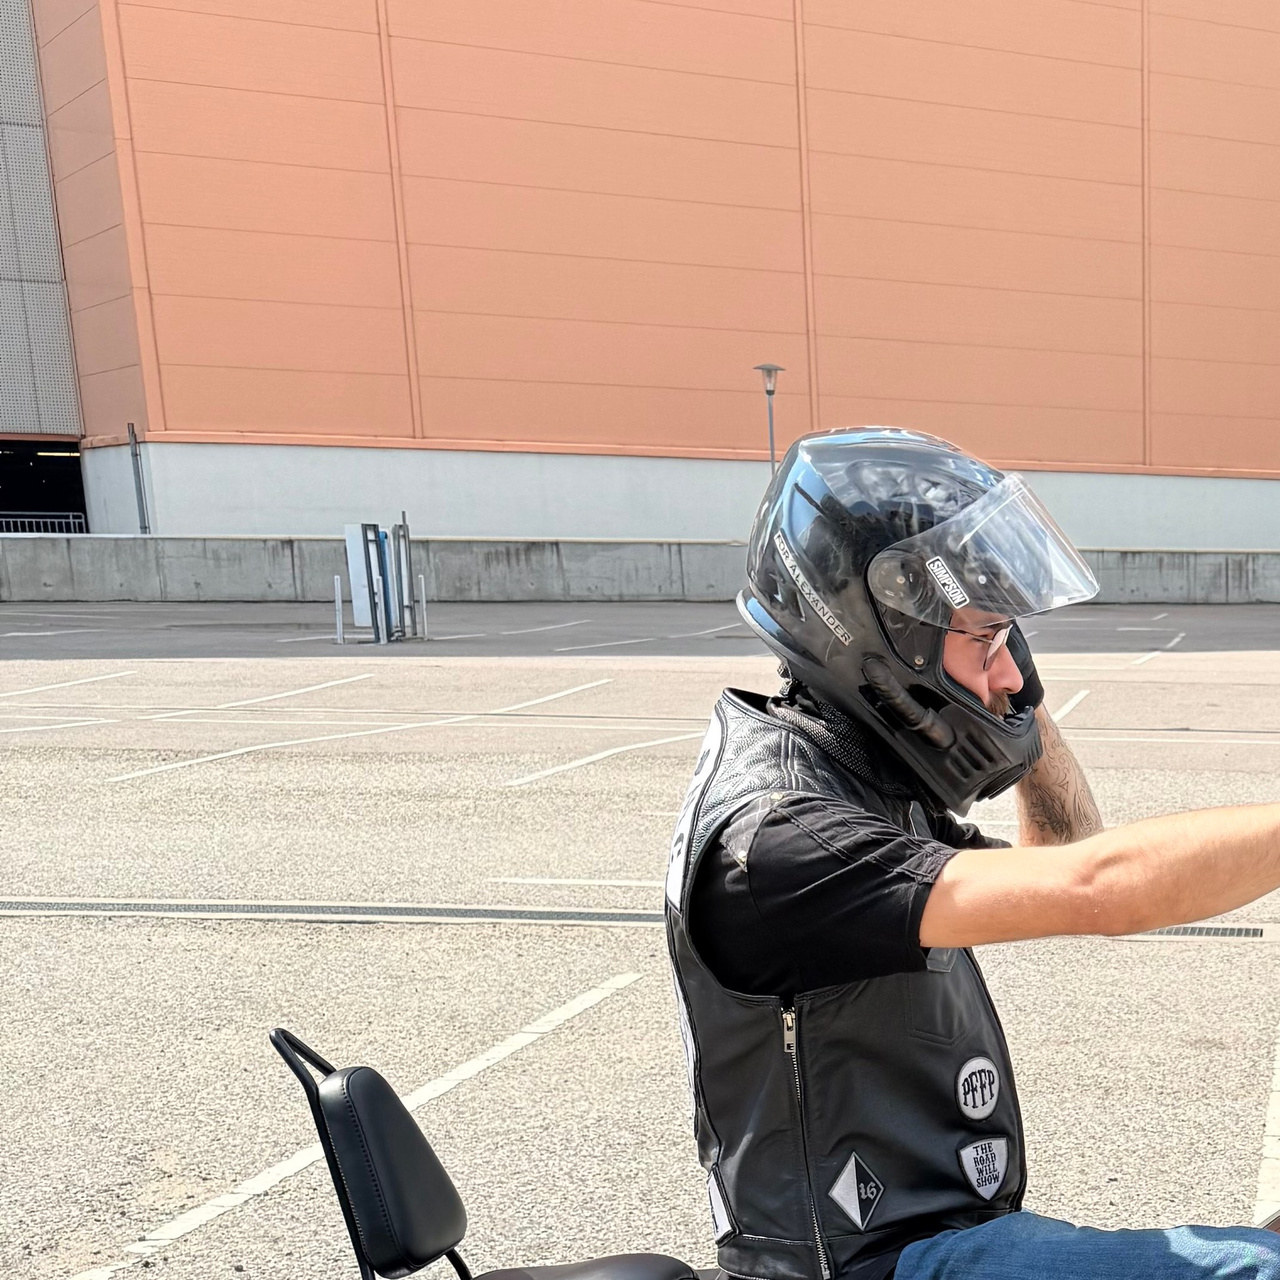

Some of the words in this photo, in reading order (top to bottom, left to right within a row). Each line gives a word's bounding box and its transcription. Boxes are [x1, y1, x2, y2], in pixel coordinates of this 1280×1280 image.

[929, 560, 966, 604] SIMPSON
[789, 564, 851, 642] ALEXANDER
[973, 1142, 993, 1156] THE
[973, 1152, 997, 1167] ROAD
[976, 1163, 998, 1177] WILL
[976, 1172, 1000, 1188] SHOW
